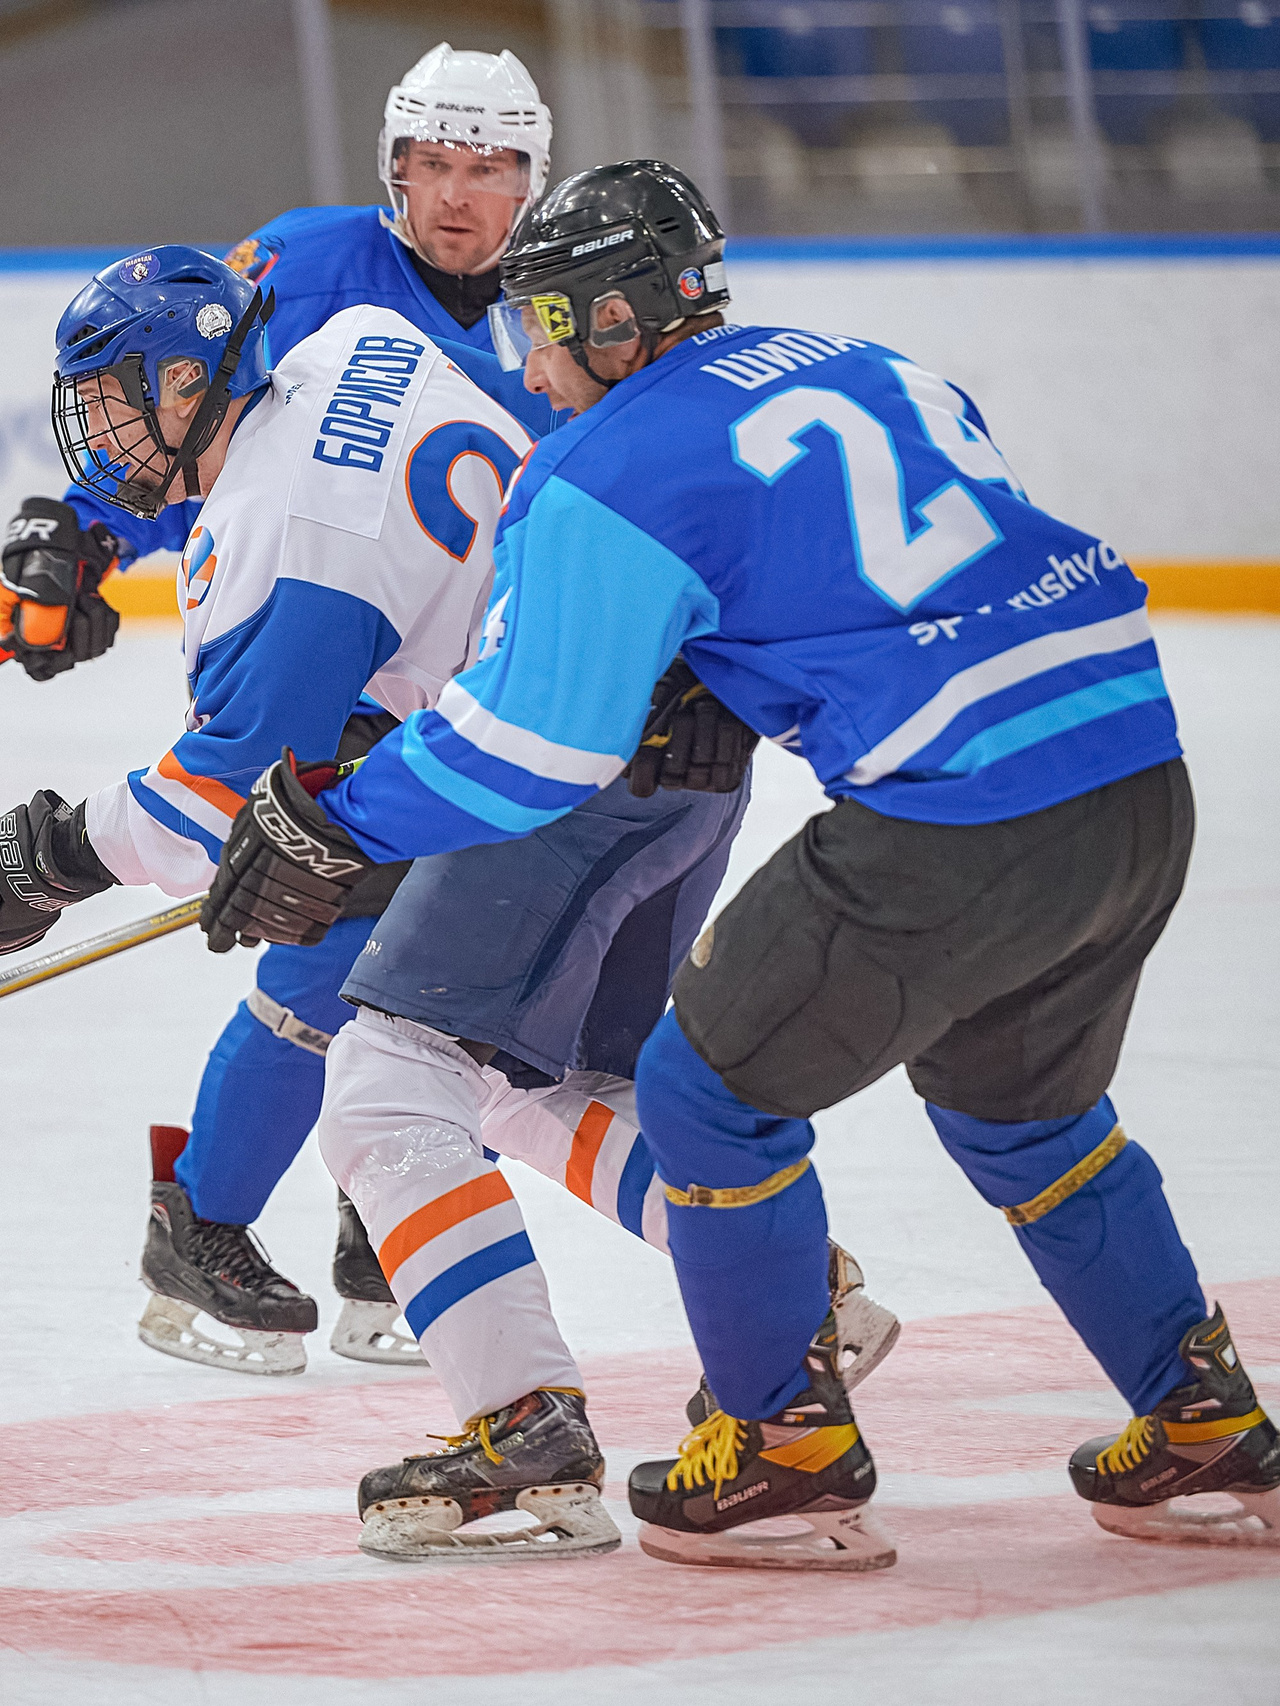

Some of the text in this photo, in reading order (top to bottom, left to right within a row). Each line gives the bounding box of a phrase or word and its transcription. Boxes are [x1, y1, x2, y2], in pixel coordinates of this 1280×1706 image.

[571, 229, 634, 258] BAUER
[312, 336, 426, 473] БОРИСОВ
[716, 1479, 770, 1512] BAUER
